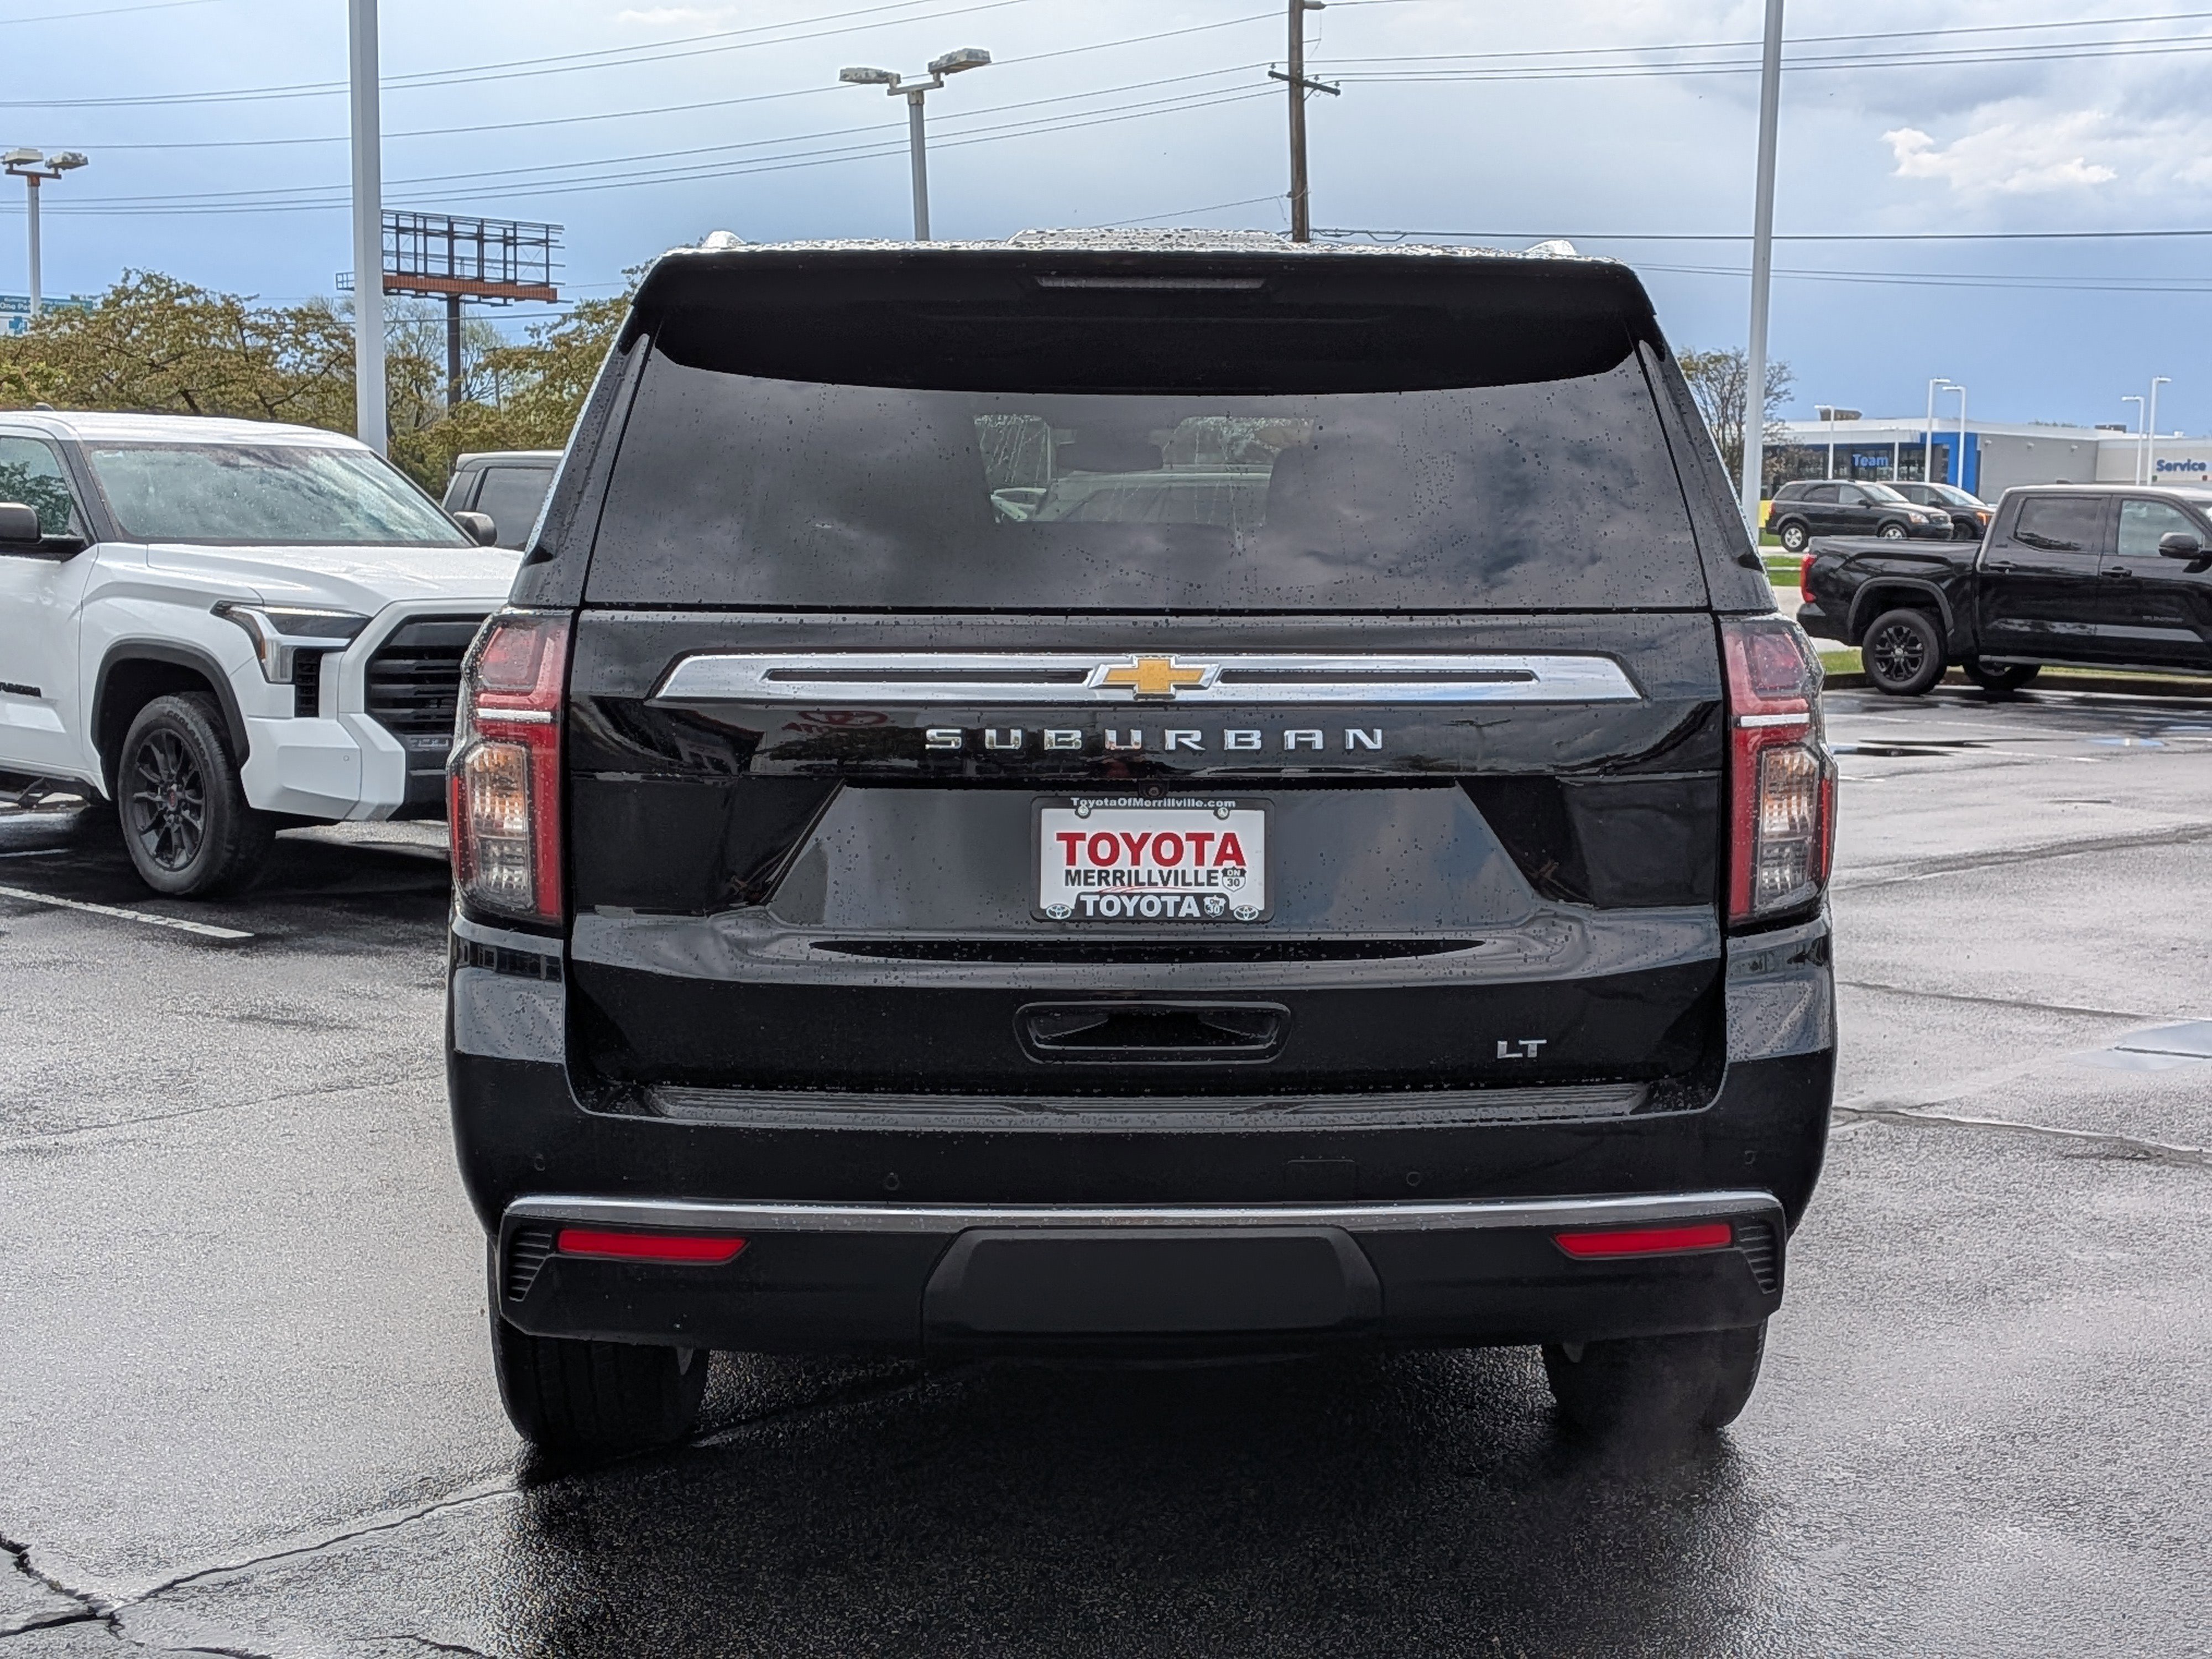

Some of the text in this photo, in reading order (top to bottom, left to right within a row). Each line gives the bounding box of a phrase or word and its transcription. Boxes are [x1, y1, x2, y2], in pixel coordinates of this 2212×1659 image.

[1853, 454, 1888, 467] Team
[2156, 458, 2206, 471] Service
[925, 728, 1384, 750] SUBURBAN
[1070, 797, 1236, 808] ToyotaOfMerrillville.com
[1056, 832, 1246, 866] TOYOTA
[1065, 869, 1219, 886] MERRILLVILLE
[1227, 878, 1240, 887] 30
[1080, 895, 1201, 917] TOYOTA
[1497, 1040, 1547, 1058] LT
